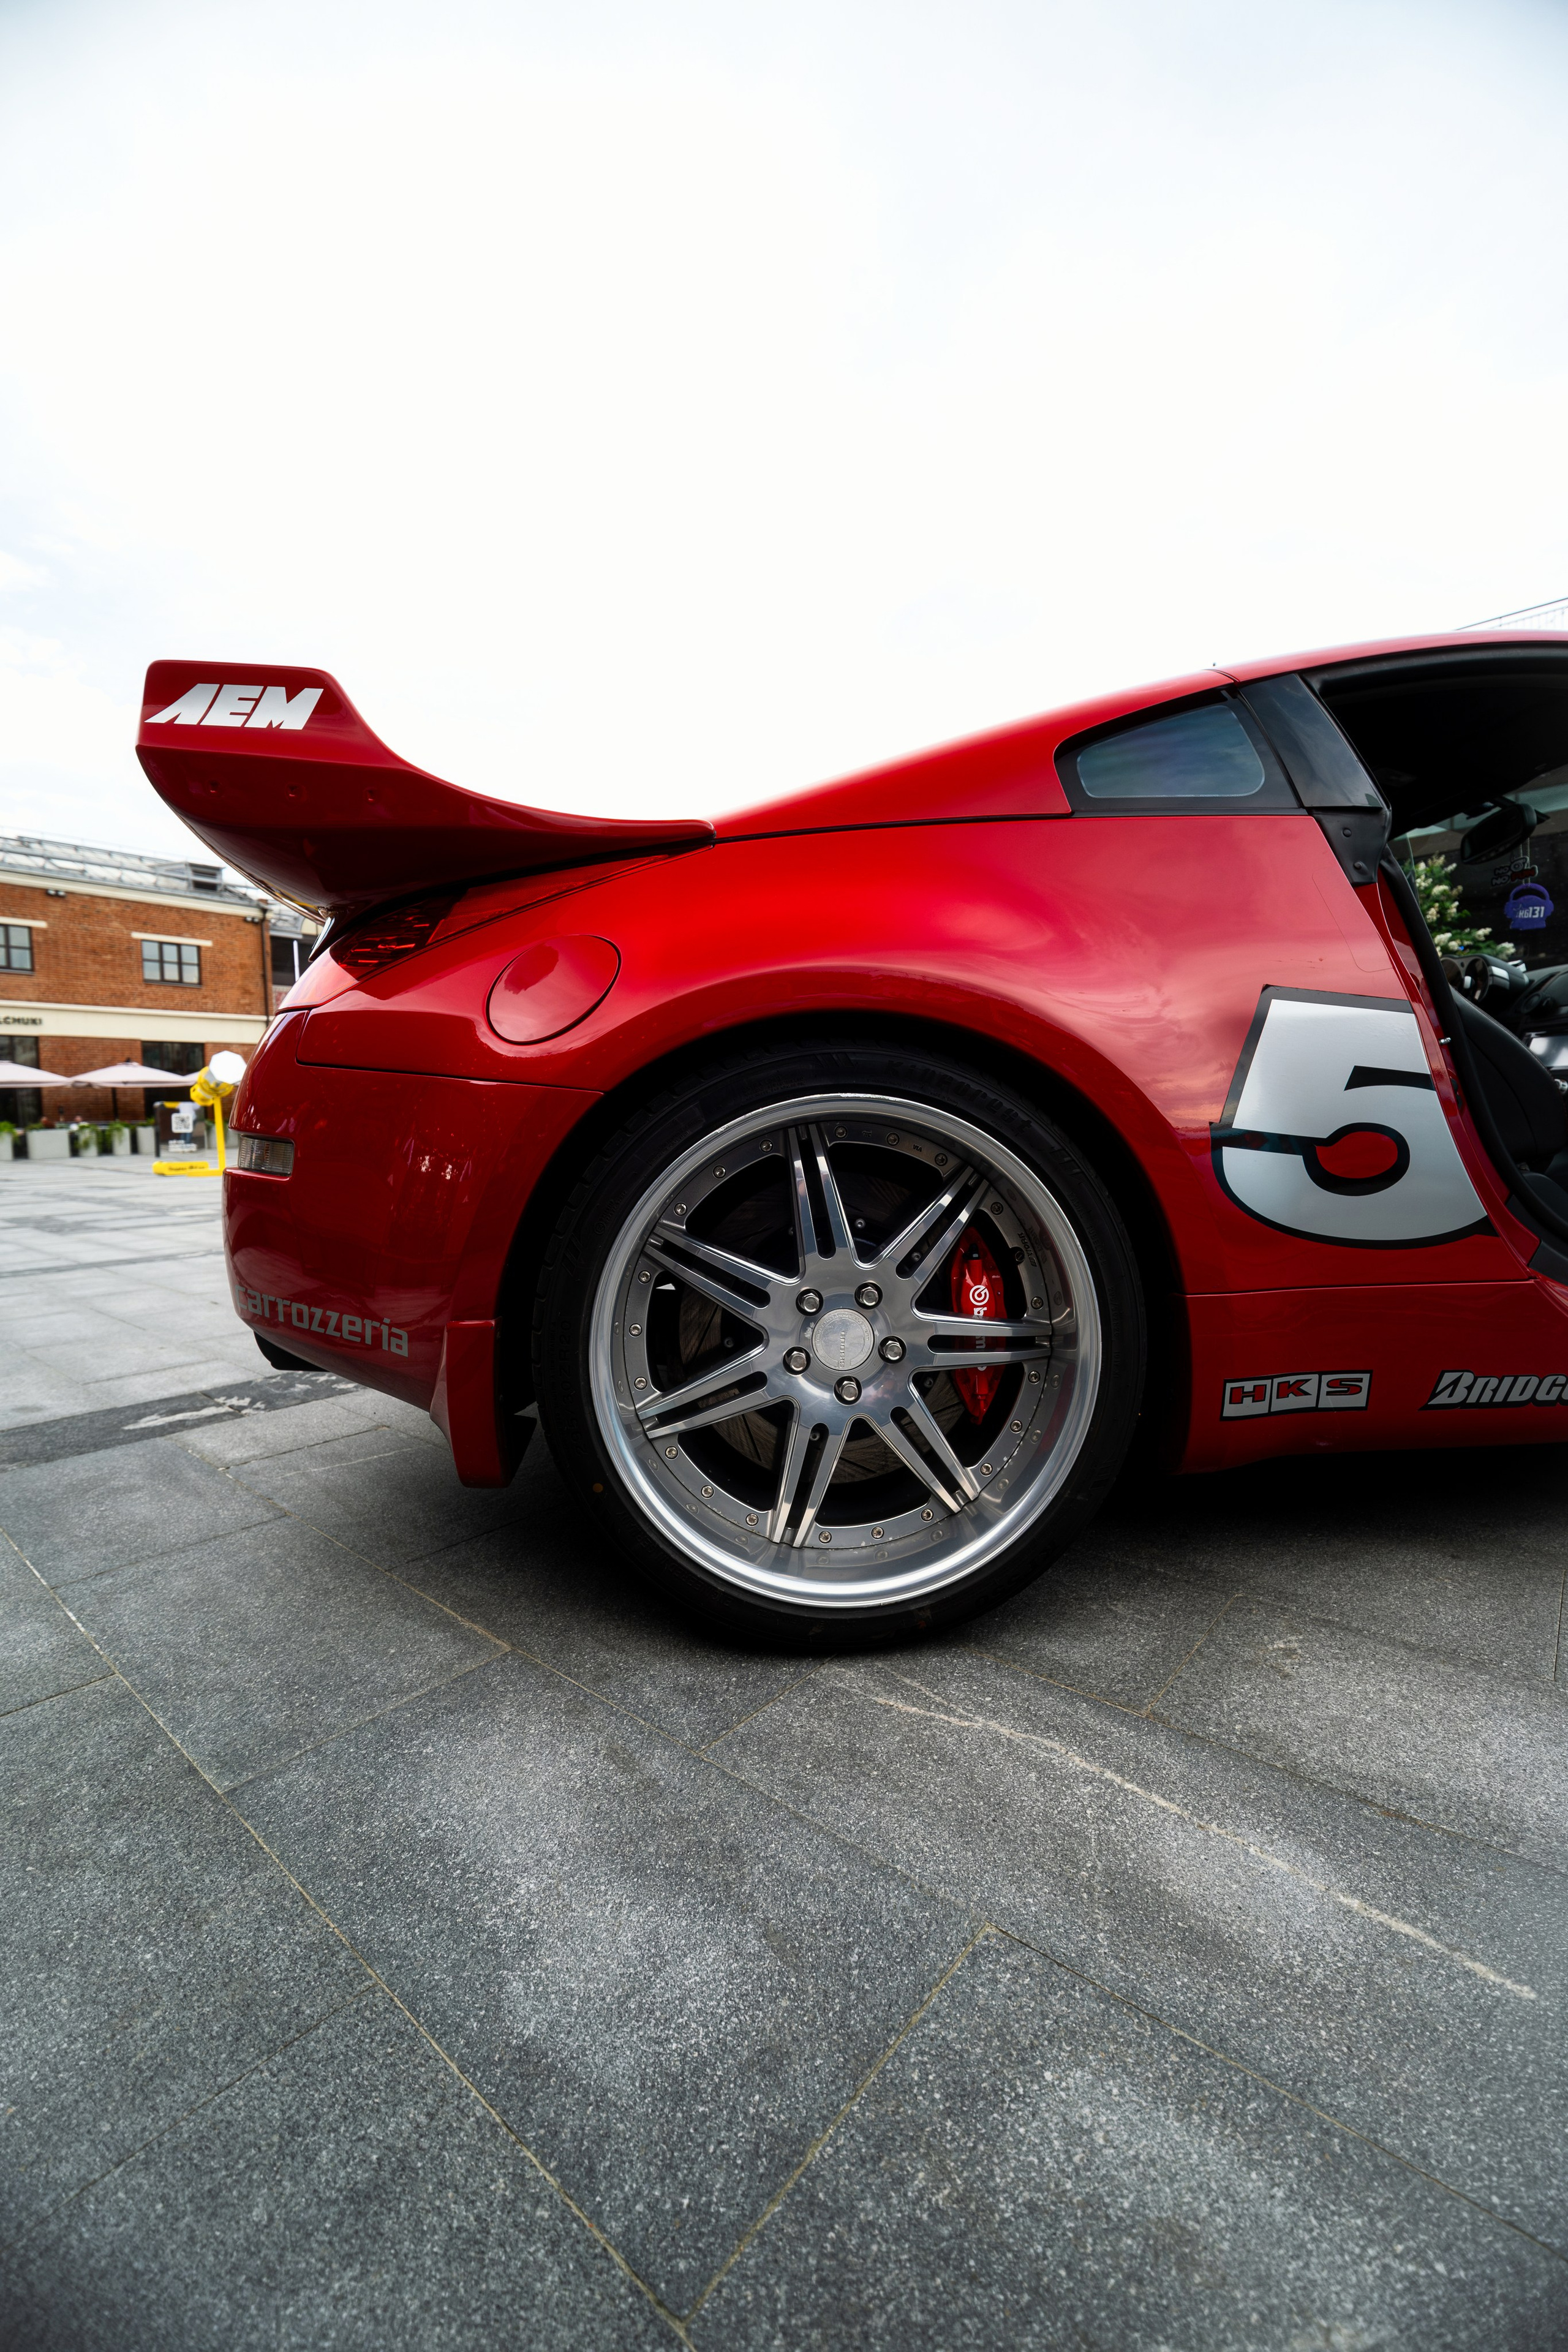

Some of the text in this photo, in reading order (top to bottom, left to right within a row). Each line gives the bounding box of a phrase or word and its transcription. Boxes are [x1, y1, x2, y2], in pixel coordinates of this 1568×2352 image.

[145, 683, 324, 730] AEM
[1216, 991, 1493, 1245] 5
[235, 1284, 409, 1358] carrozzeria
[1227, 1376, 1365, 1406] HKS
[1425, 1370, 1568, 1408] BRIDG
